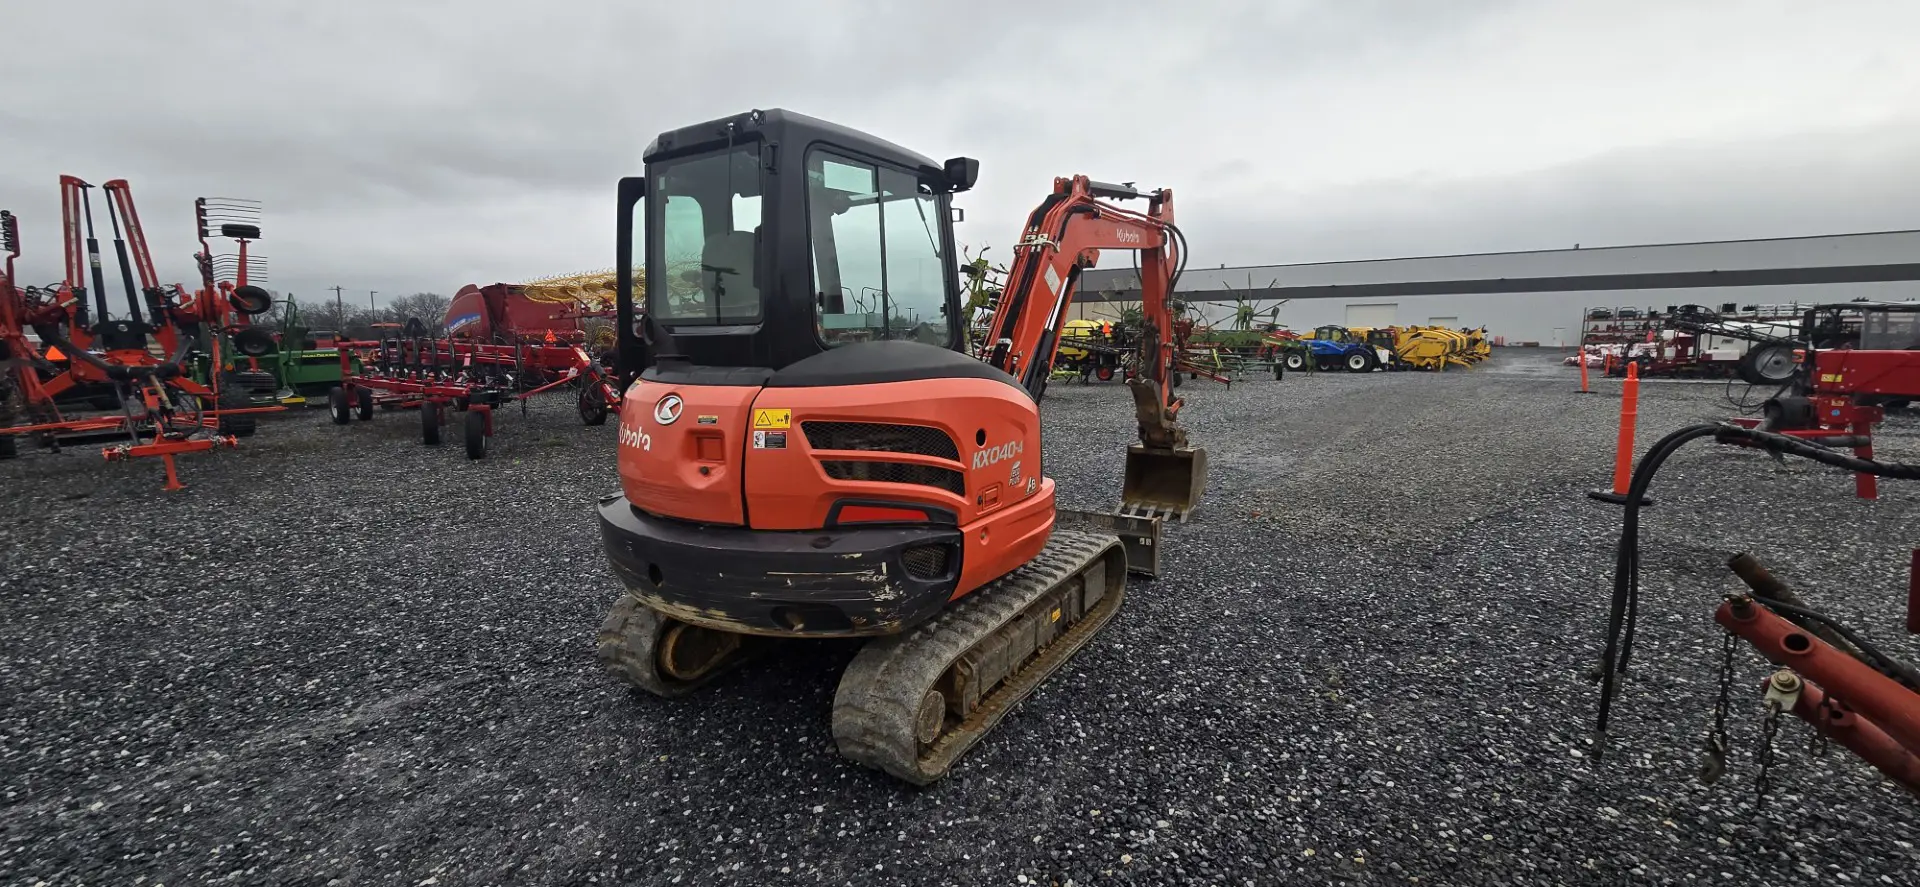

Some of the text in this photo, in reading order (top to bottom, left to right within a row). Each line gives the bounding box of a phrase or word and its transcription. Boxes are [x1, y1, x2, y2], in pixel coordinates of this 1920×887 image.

[1116, 228, 1140, 243] Kubota
[619, 421, 651, 451] Kubota
[972, 440, 1023, 470] KX040-4
